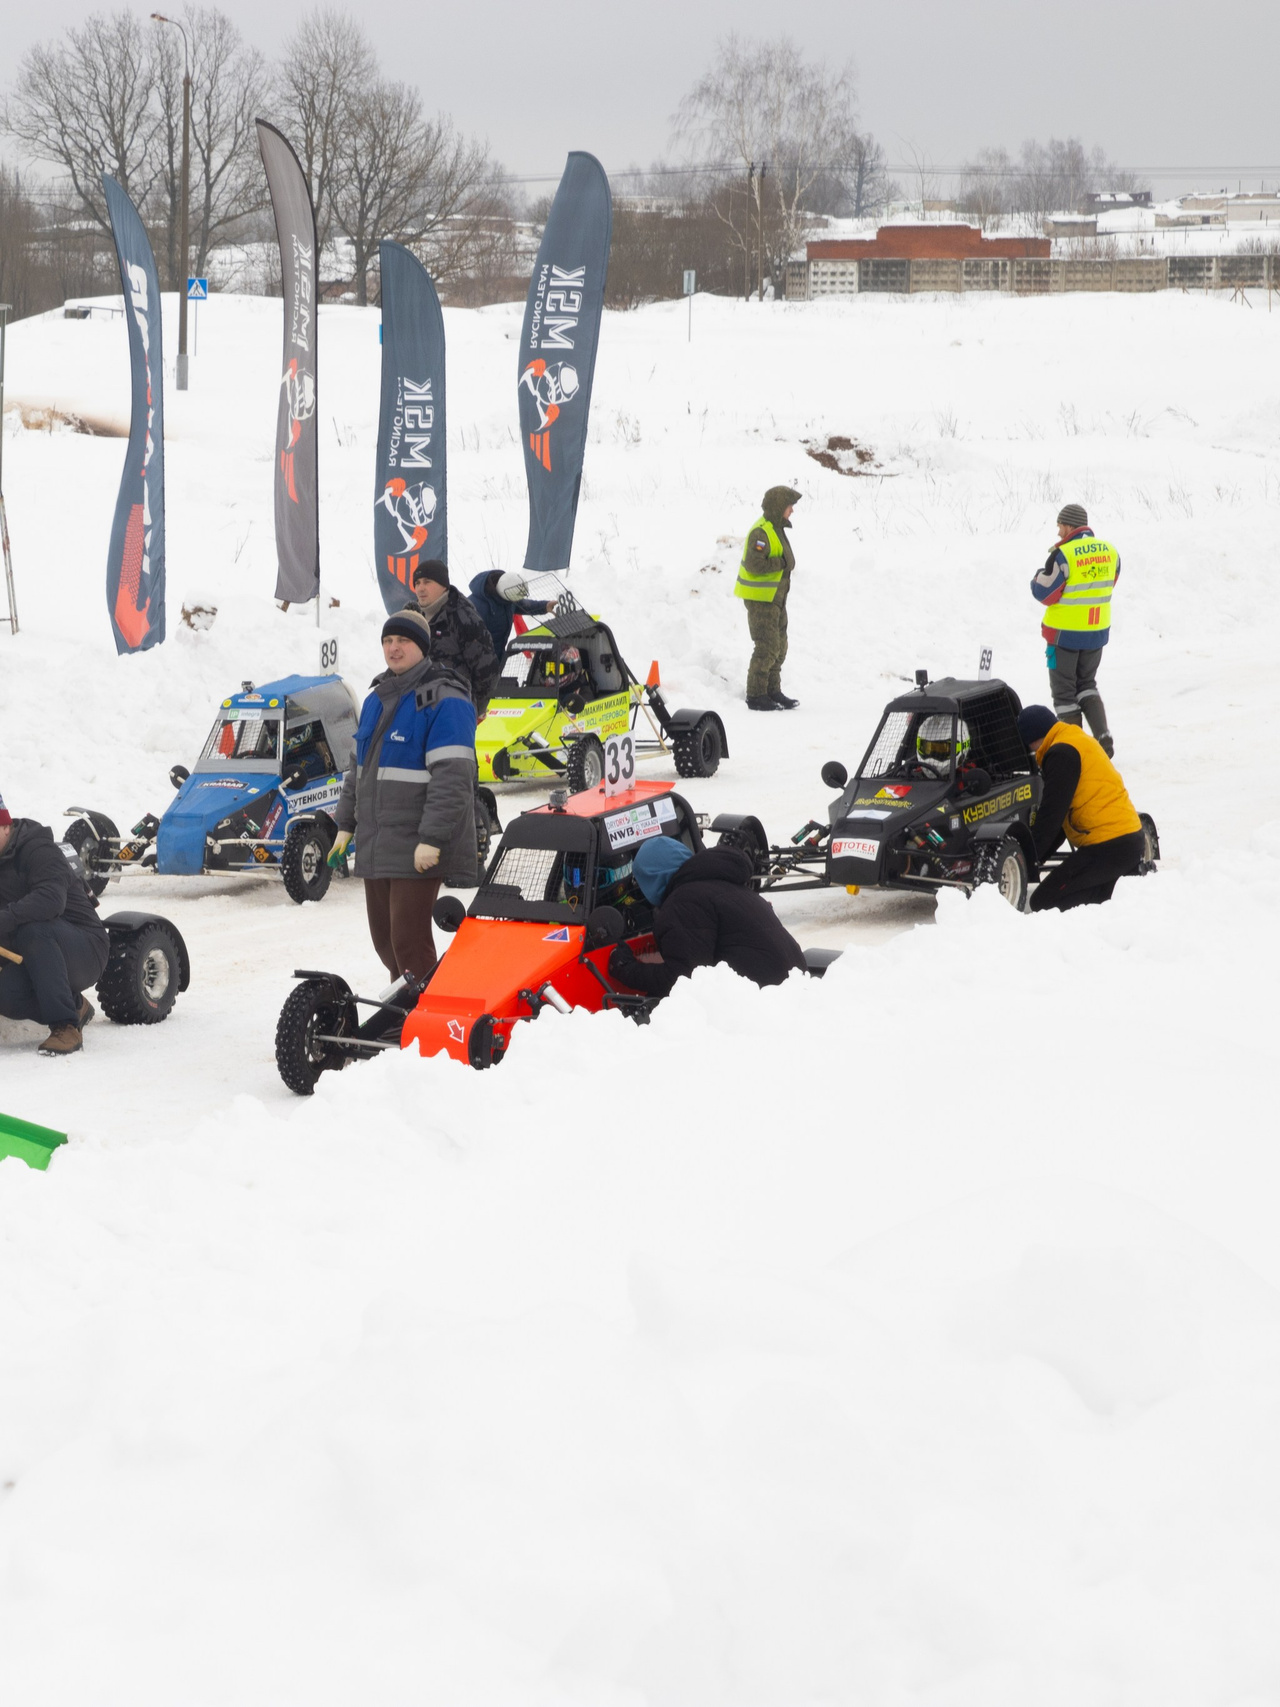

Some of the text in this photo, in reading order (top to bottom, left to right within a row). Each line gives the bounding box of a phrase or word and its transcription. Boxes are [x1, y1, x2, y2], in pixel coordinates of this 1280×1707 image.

[1074, 543, 1109, 556] RUSTA
[1076, 555, 1112, 568] МАРШАЛ
[321, 638, 338, 669] 89
[979, 648, 993, 671] 69
[606, 736, 635, 785] 33
[962, 791, 1012, 825] КУЗОВЛЕВ
[1012, 783, 1032, 804] ЛЕВ
[842, 841, 876, 853] TOTEK
